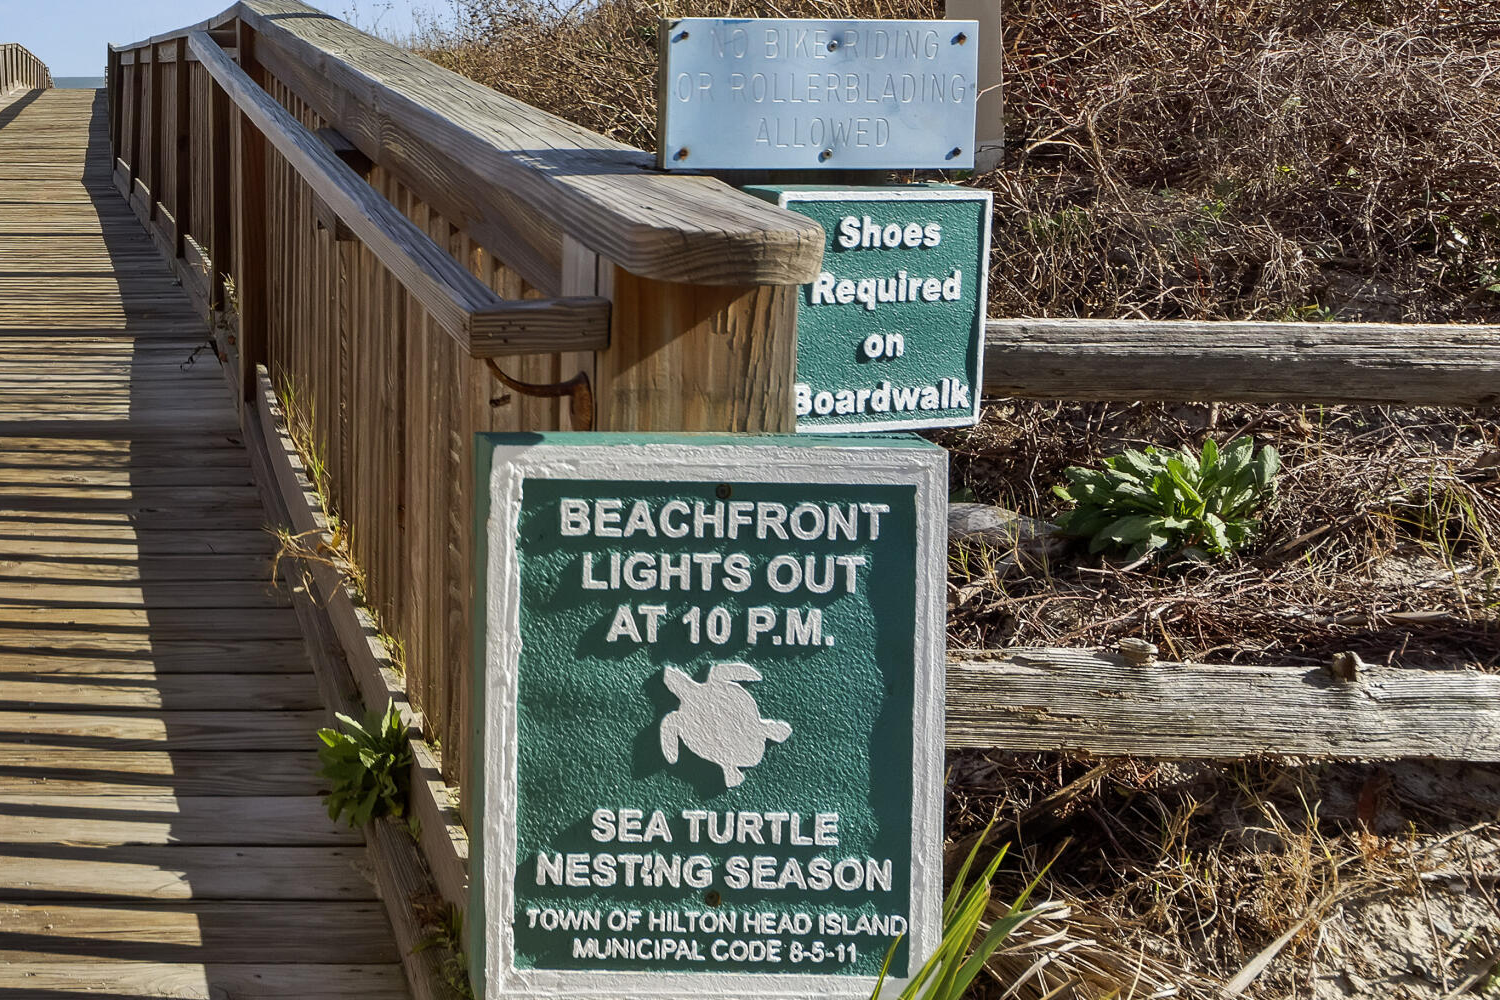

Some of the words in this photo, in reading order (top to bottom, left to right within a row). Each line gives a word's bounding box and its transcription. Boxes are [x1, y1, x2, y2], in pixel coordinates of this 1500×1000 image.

[709, 28, 749, 60] NO
[764, 29, 829, 60] BIKE
[843, 29, 940, 60] RIDING
[676, 72, 715, 104] OR
[731, 72, 967, 105] ROLLERBLADING
[755, 117, 891, 149] ALLOWED
[837, 215, 942, 249] Shoes
[811, 269, 963, 312] Required
[863, 332, 905, 359] on
[794, 377, 971, 417] Boardwalk
[560, 498, 891, 541] BEACHFRONT
[581, 552, 752, 593] LIGHTS
[766, 554, 867, 594] OUT
[605, 604, 668, 644] AT
[682, 606, 733, 646] 10
[747, 606, 835, 648] P.M.
[590, 808, 673, 843] SEA
[681, 809, 840, 847] TURTLE
[535, 852, 714, 889] NESTING
[723, 857, 893, 892] SEASON
[526, 909, 601, 931] TOWN
[607, 910, 641, 932] OF
[648, 911, 736, 935] HILTON
[743, 913, 813, 936] HEAD
[818, 914, 909, 938] ISLAND
[572, 937, 706, 962] MUNICIPAL
[710, 939, 782, 963] CODE
[789, 942, 858, 964] 8-5-11
